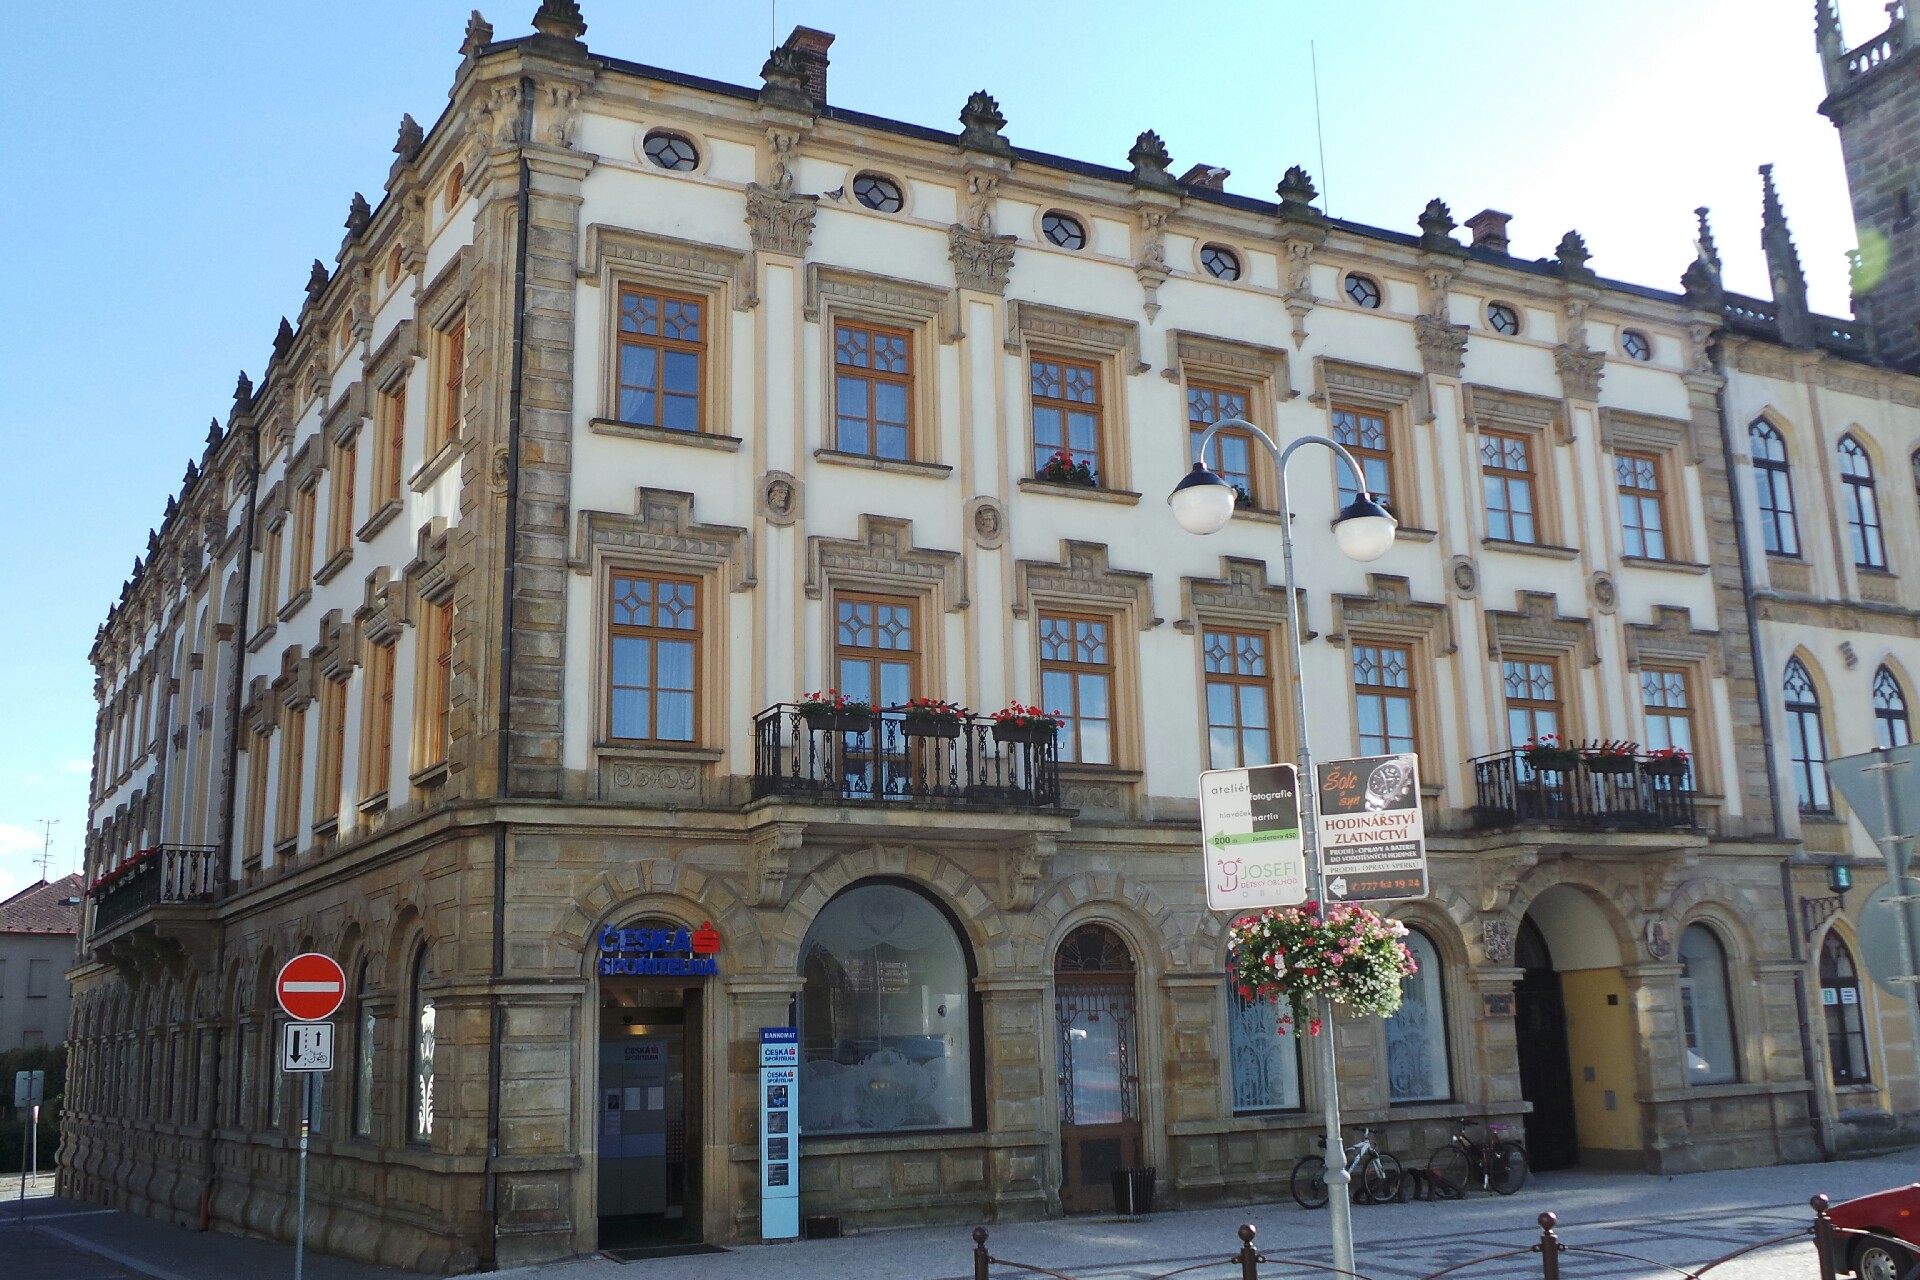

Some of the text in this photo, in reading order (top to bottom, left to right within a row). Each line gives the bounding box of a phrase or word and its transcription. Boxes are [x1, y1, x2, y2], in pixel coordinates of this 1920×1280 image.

[1323, 766, 1358, 791] Šolc
[1211, 782, 1250, 795] ateliér
[1249, 789, 1293, 801] fotografie
[1339, 795, 1361, 809] syn
[1219, 808, 1251, 819] hlaváček
[1251, 812, 1279, 822] martin
[1325, 811, 1415, 830] HODINÁŘSTVÍ
[1214, 836, 1231, 845] 200
[1334, 826, 1408, 844] ZLATNICTVÍ
[1329, 848, 1354, 856] PRODEJ
[1358, 846, 1384, 854] OPRAVY
[1390, 843, 1416, 851] BATERIE
[1341, 852, 1387, 862] VODOTĚSNÝCH
[1387, 850, 1418, 859] HODINEK
[1241, 861, 1297, 880] JOSEFI
[1330, 865, 1357, 873] PRODEJ
[1362, 863, 1390, 871] OPRAVY
[1267, 878, 1298, 886] OBCHOD
[1360, 882, 1378, 891] 777
[1394, 879, 1405, 889] 19
[598, 922, 692, 952] ČESKÁ
[598, 953, 719, 976] SPOŘITELNA
[764, 1048, 789, 1056] ČESKÁ
